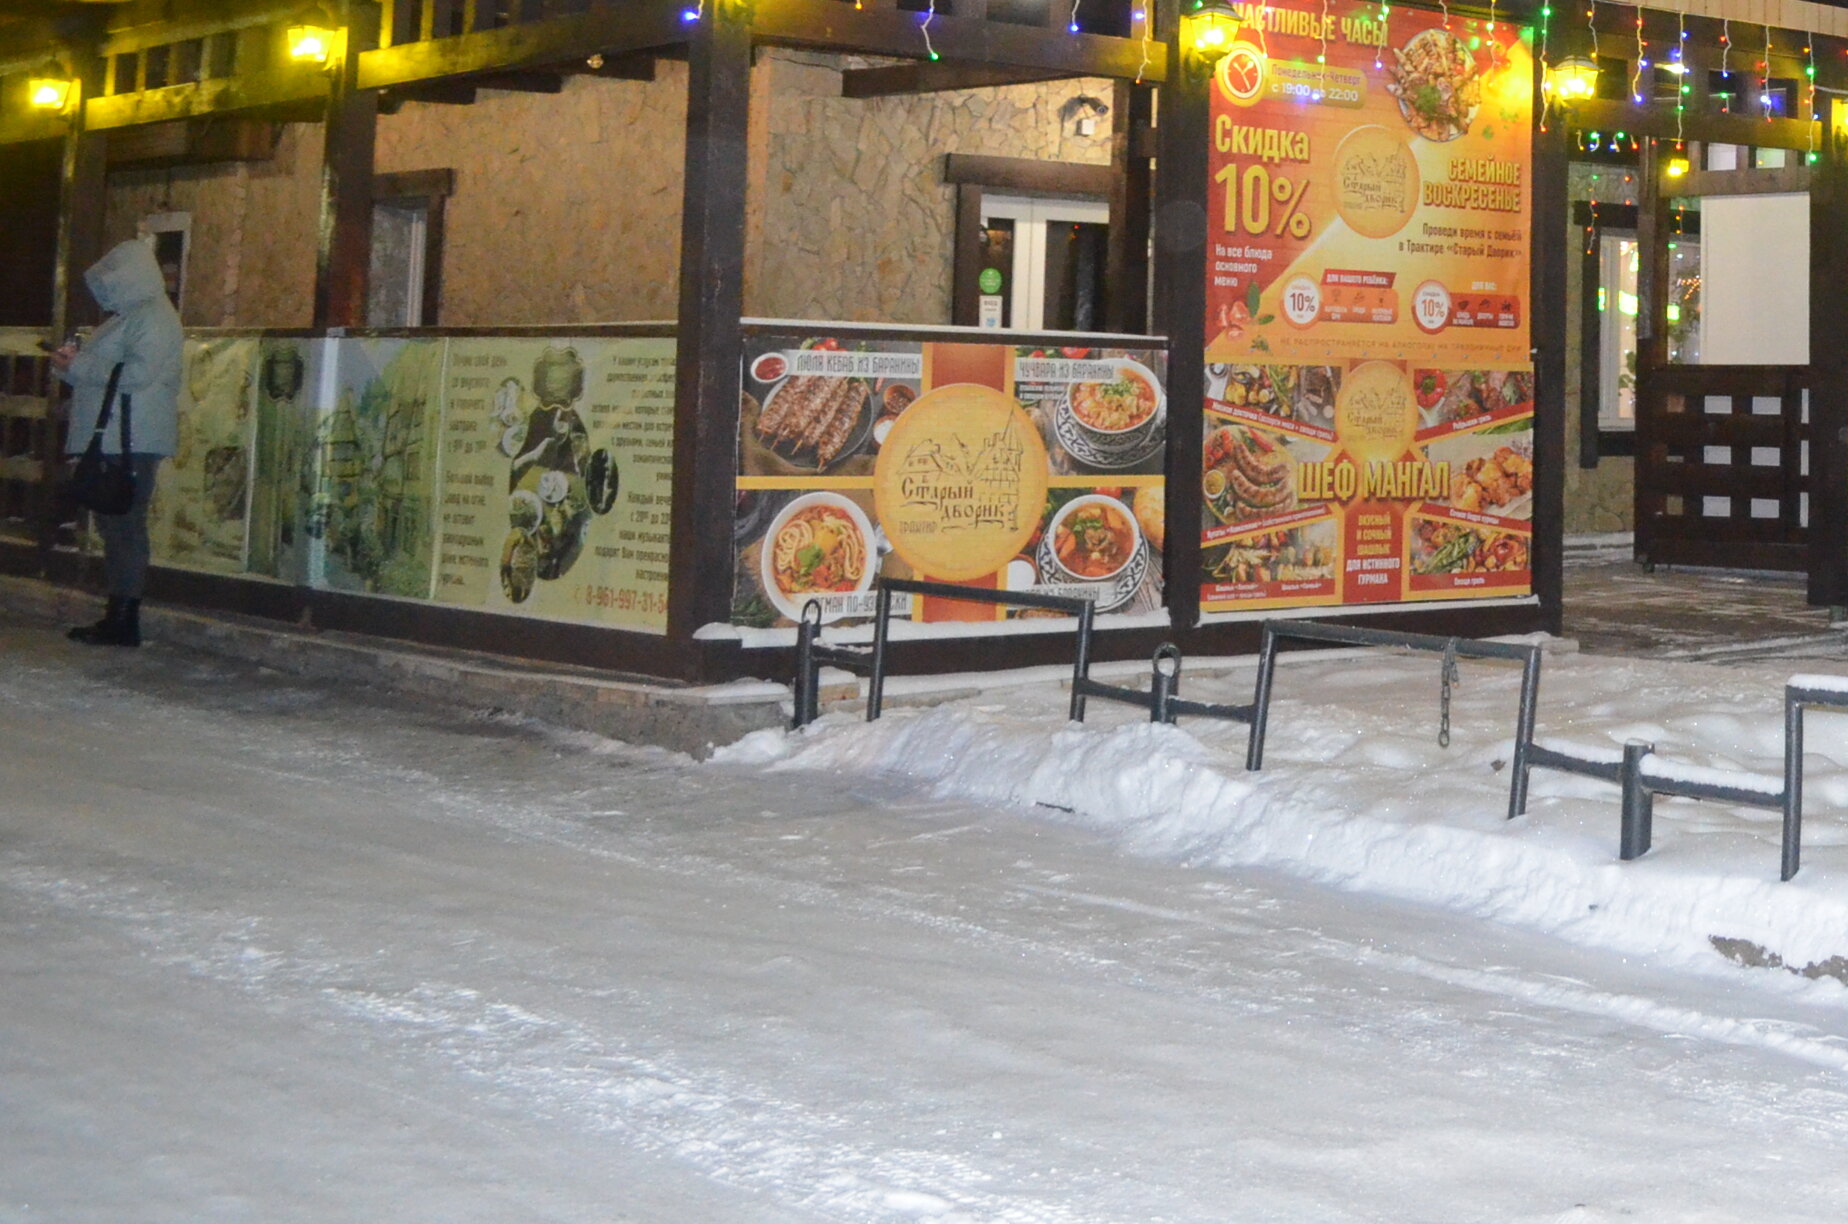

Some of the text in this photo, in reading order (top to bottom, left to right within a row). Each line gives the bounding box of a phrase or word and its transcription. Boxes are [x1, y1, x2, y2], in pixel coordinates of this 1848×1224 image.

[1230, 2, 1388, 47] ЧАСТЛИВЫЕ ЧАСЫ
[1328, 88, 1359, 102] 22:00
[1215, 113, 1310, 164] Скидка
[1448, 156, 1521, 186] СЕМЕЙНОЕ
[1214, 163, 1313, 240] 10%
[1423, 181, 1521, 214] ВОСКРЕСЕНЬЕ
[1422, 222, 1457, 239] Проведи
[1460, 227, 1486, 241] время
[1244, 245, 1273, 261] блюда
[1398, 241, 1404, 251] в
[1406, 238, 1445, 256] Трактире
[1290, 292, 1316, 313] 10%
[1421, 299, 1446, 319] 10%
[827, 355, 854, 373] КЕБАБ
[857, 356, 869, 373] ИЗ
[872, 356, 920, 374] БАРАНИНЫ
[1297, 459, 1451, 501] ШЕФ МАНГАЛ
[901, 475, 974, 512] Старый
